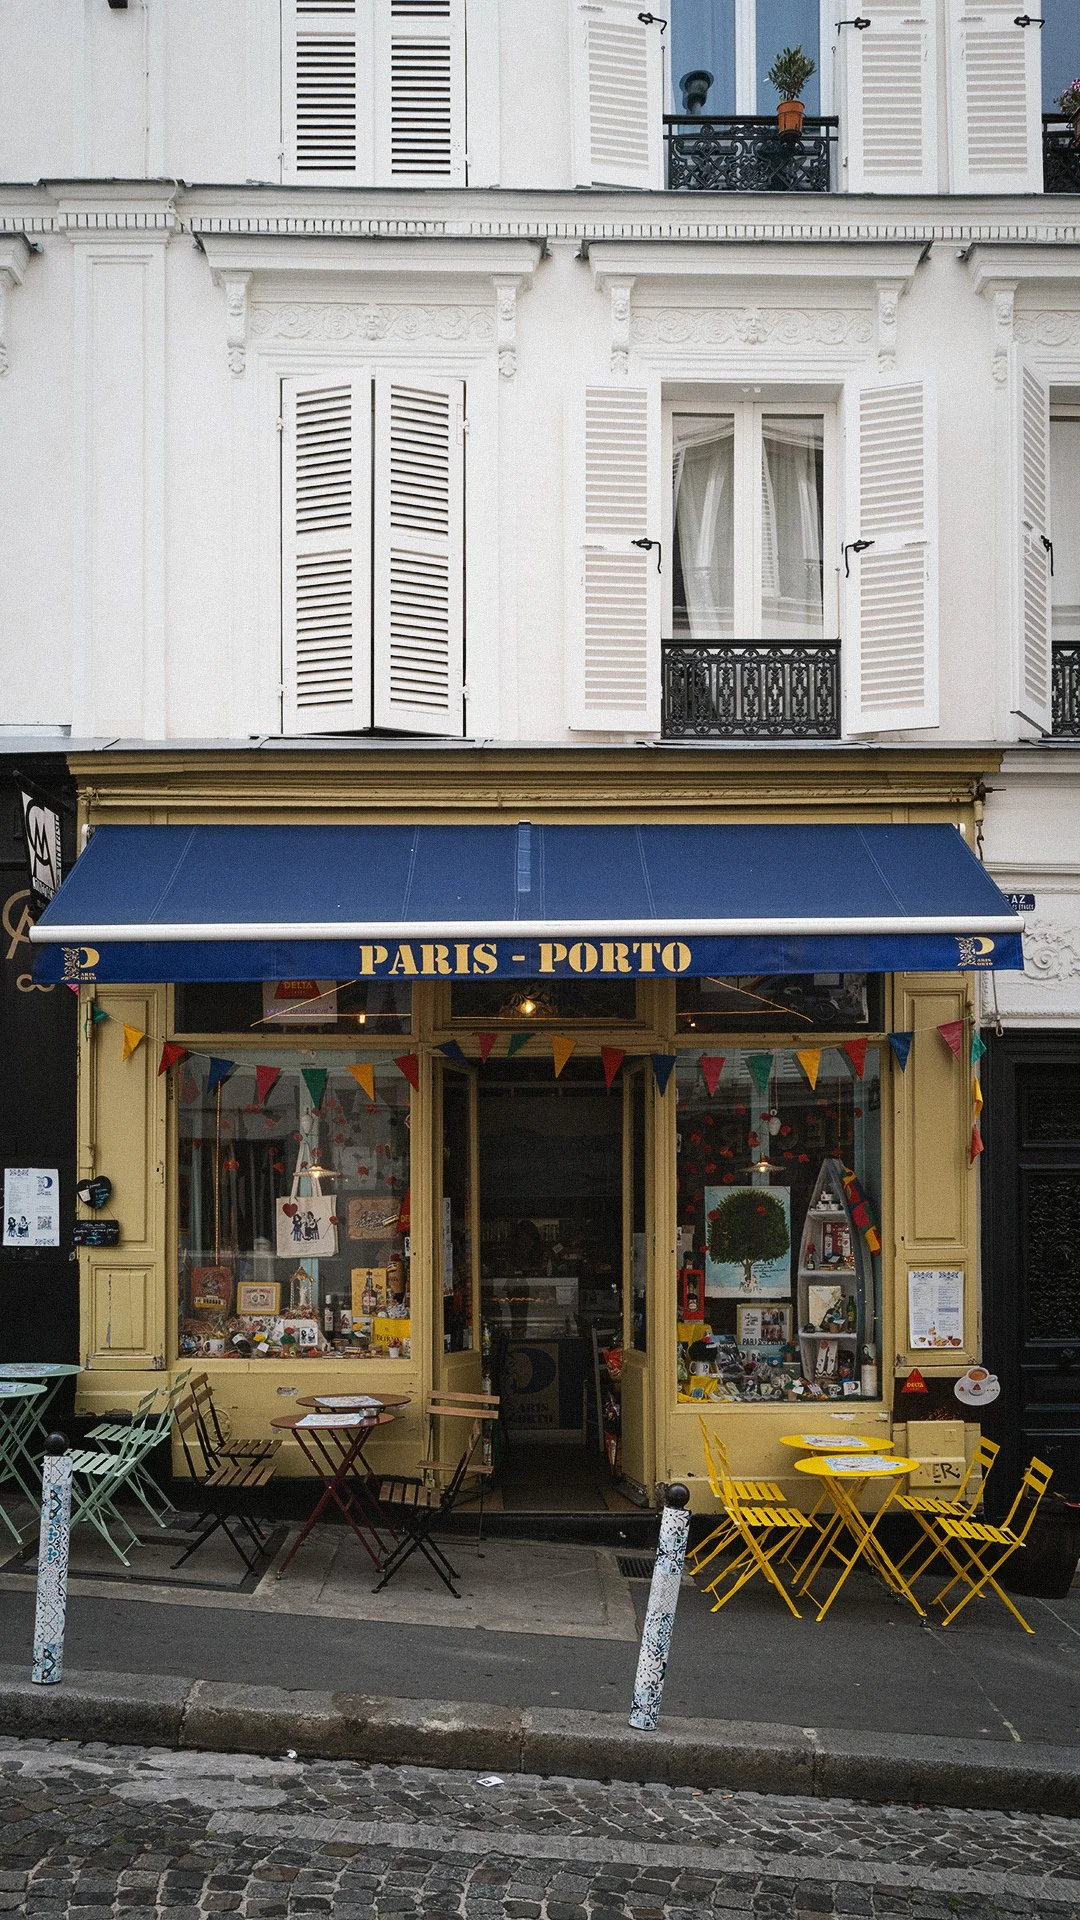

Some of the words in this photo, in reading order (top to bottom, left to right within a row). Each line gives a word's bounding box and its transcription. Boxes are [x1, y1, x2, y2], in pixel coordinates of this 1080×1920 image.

[359, 943, 498, 976] PARIS
[538, 942, 693, 973] PORTO
[283, 981, 313, 989] DELTA
